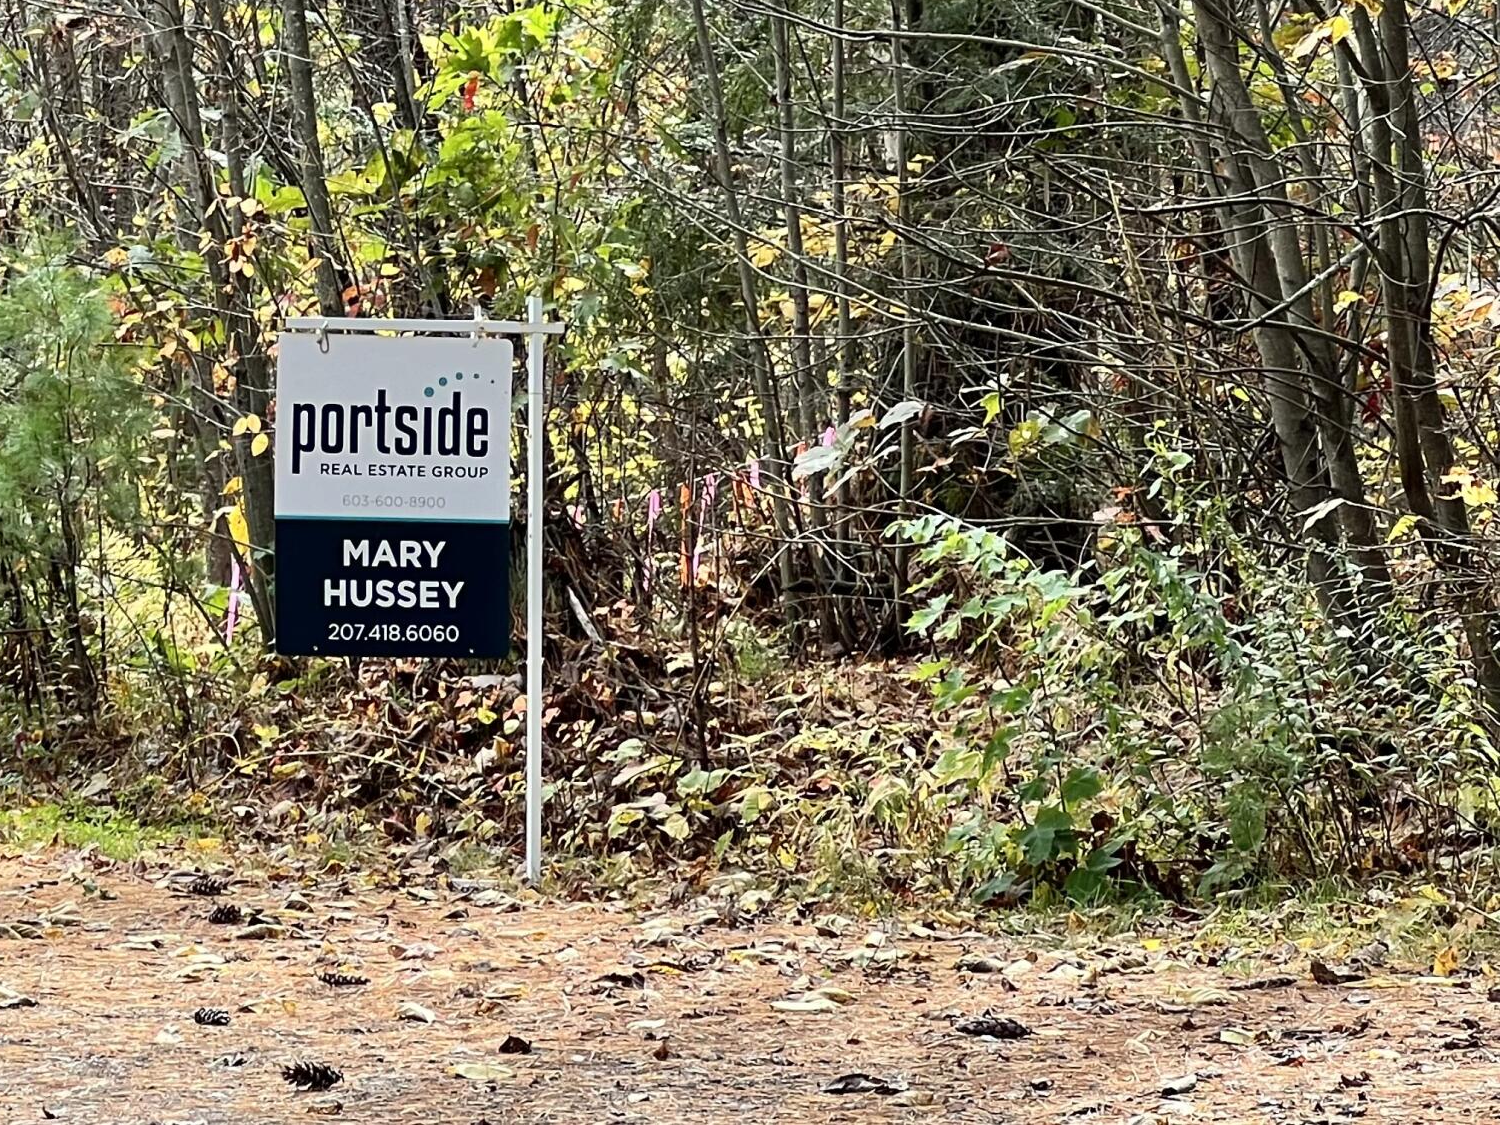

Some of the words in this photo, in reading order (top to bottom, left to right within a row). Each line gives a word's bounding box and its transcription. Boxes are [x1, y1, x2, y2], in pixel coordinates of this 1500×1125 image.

[291, 388, 489, 474] portside
[320, 463, 362, 476] REAL
[368, 464, 426, 478] ESTATE
[431, 465, 489, 479] GROUP
[342, 494, 446, 509] 603-600-8900
[342, 539, 446, 568] MARY
[323, 578, 465, 608] HUSSEY
[327, 623, 460, 643] 207.418.6060
